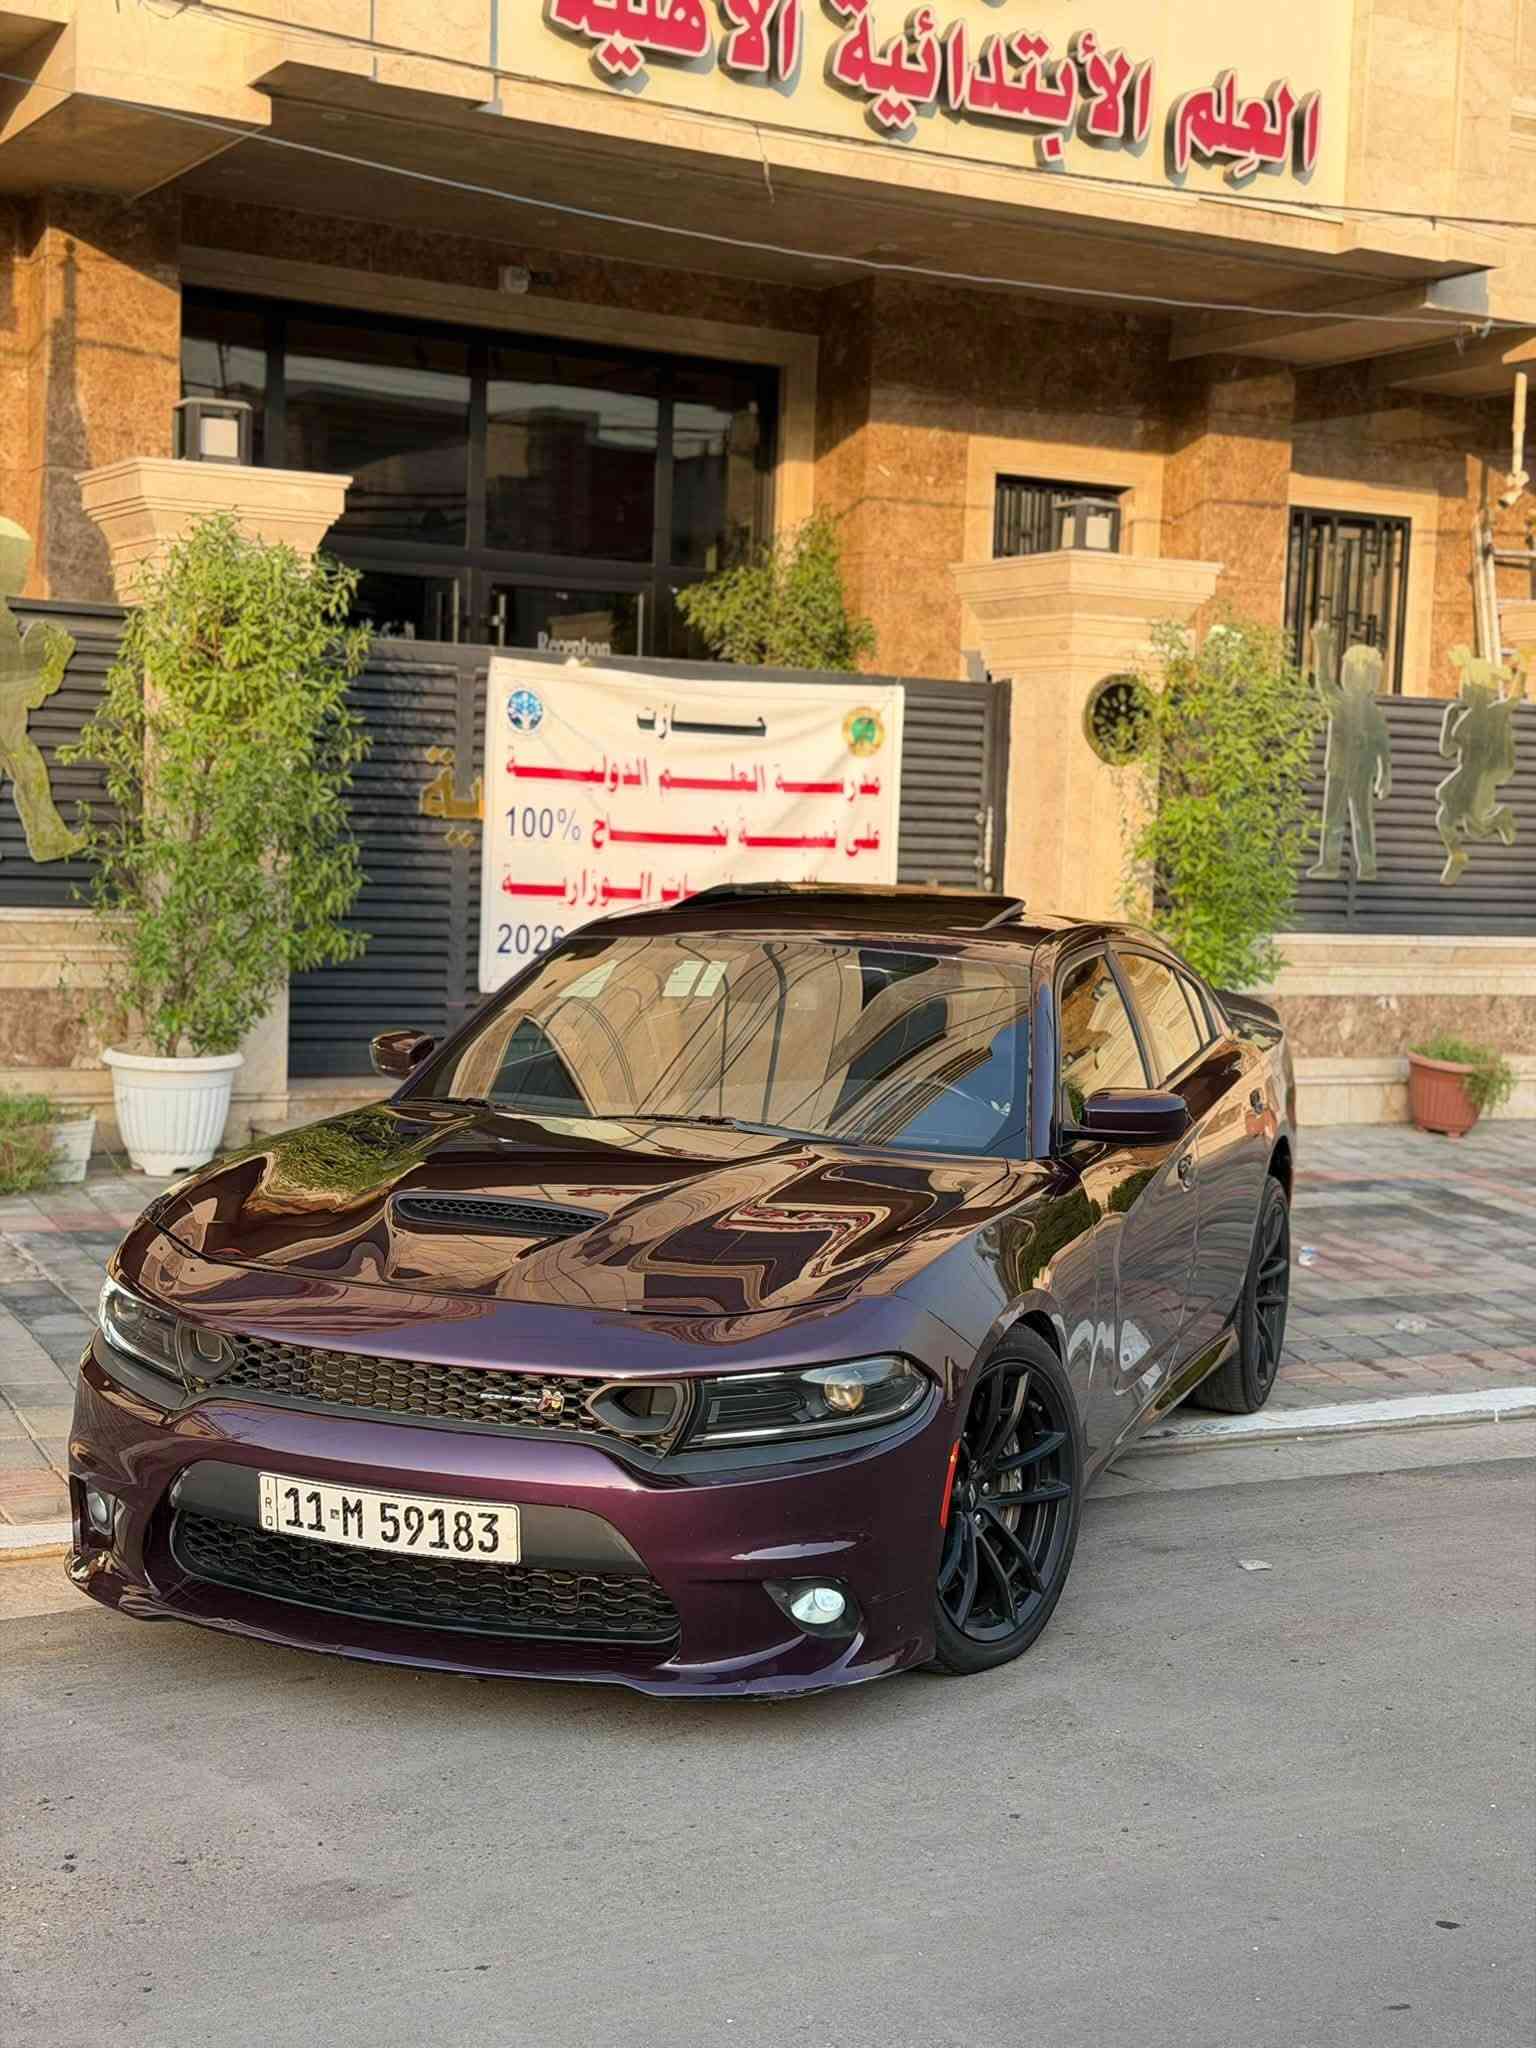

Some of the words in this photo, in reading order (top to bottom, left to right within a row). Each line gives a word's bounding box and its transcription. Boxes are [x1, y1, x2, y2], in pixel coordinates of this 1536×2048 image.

[506, 745, 649, 793] الدولية
[659, 761, 766, 803] العلم
[775, 763, 881, 803] مدرسة
[505, 806, 581, 841] 100%
[591, 812, 729, 854] نجاح
[738, 816, 838, 856] نسبة
[845, 821, 880, 857] على
[379, 1502, 499, 1553] 59183
